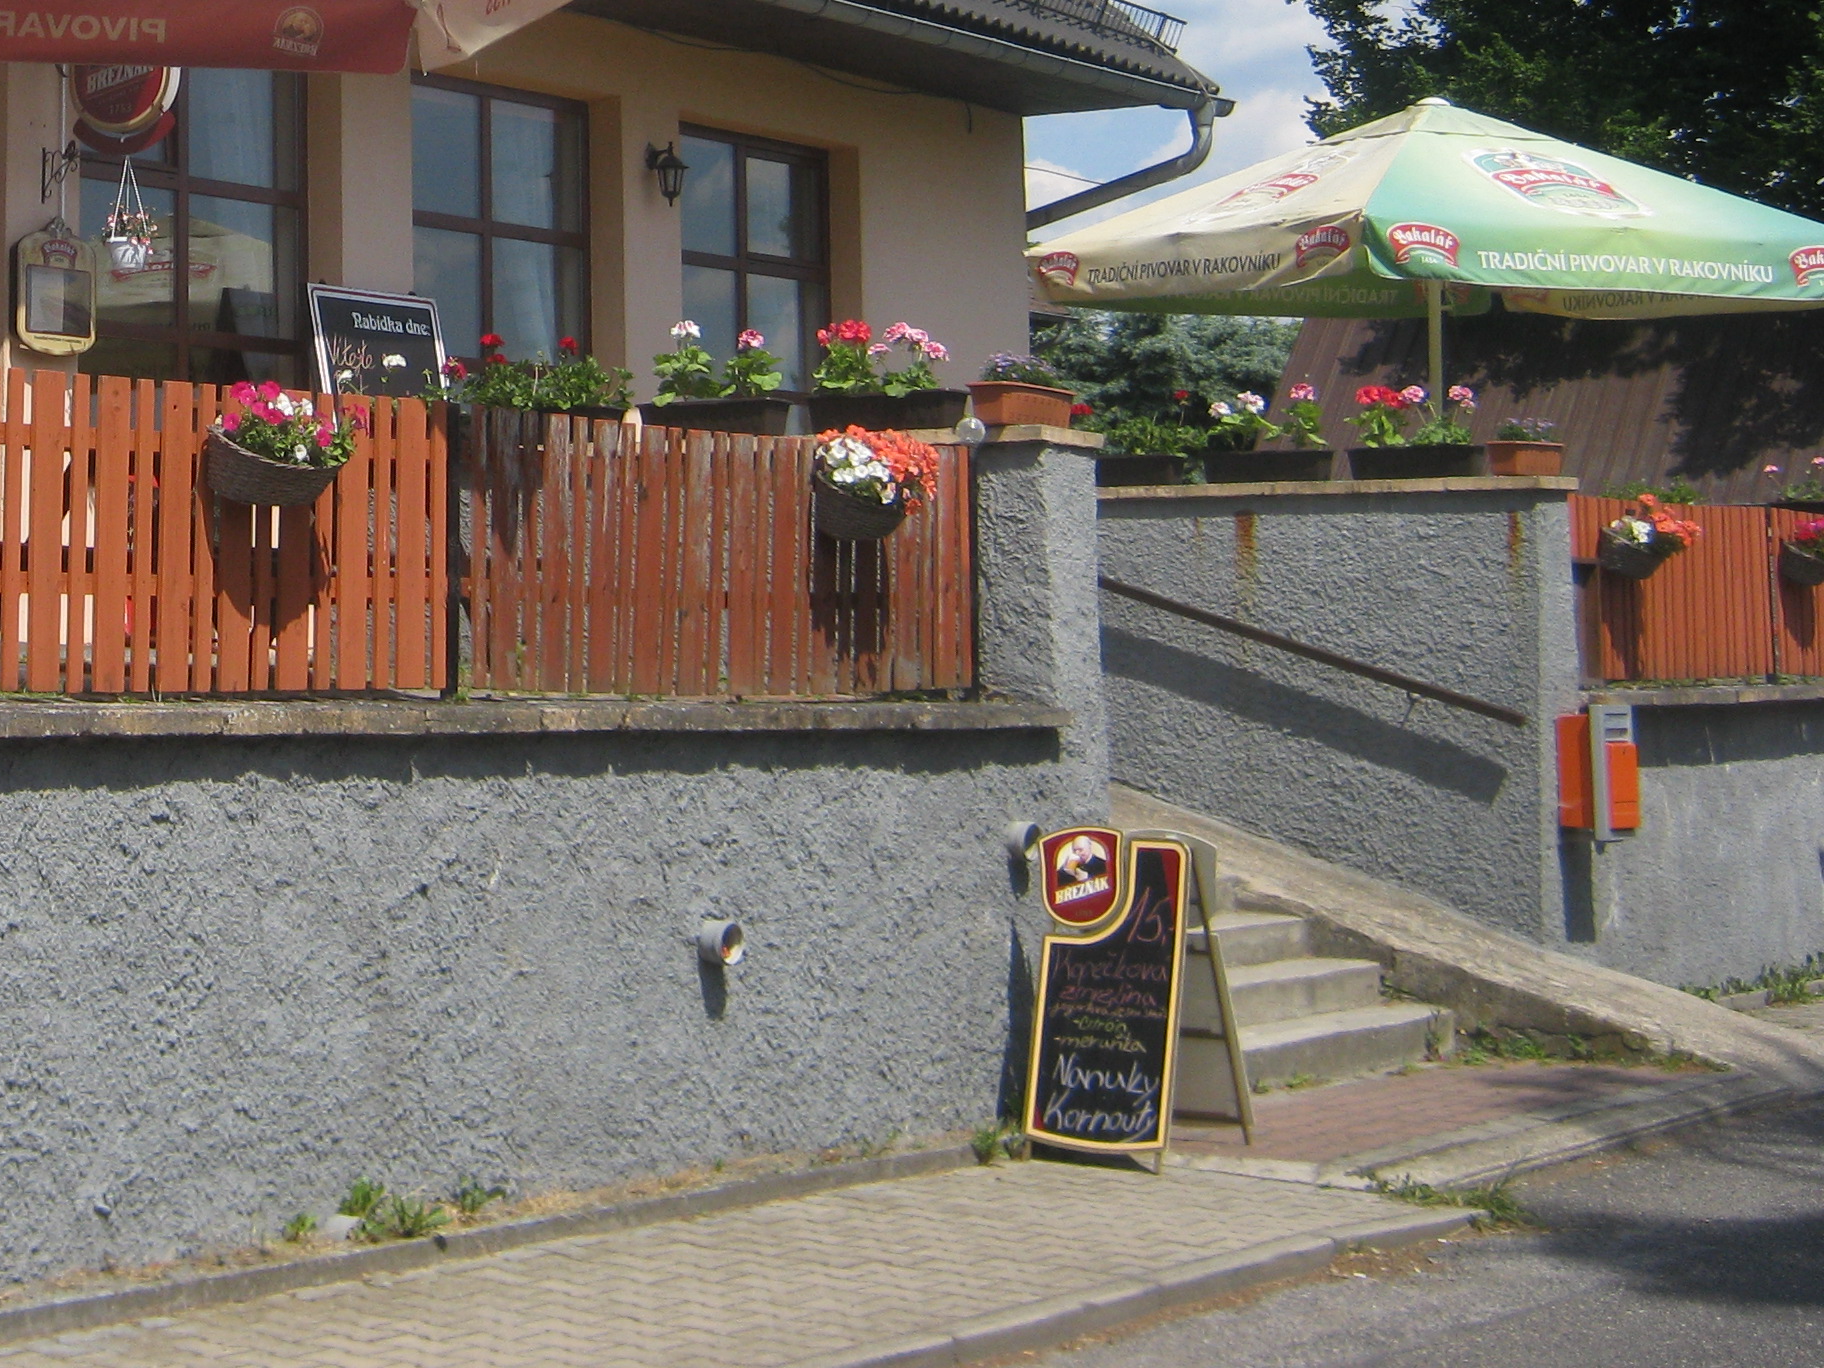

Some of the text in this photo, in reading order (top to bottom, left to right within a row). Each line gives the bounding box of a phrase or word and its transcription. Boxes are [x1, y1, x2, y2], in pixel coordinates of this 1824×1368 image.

[1087, 250, 1281, 284] TRADIČNÍ PIVOVAR V RAKOVNÍKU
[1477, 249, 1774, 283] TRADIČNÍ PIVOVAR V RAKOVNÍKU
[1052, 1051, 1160, 1107] Nanuky
